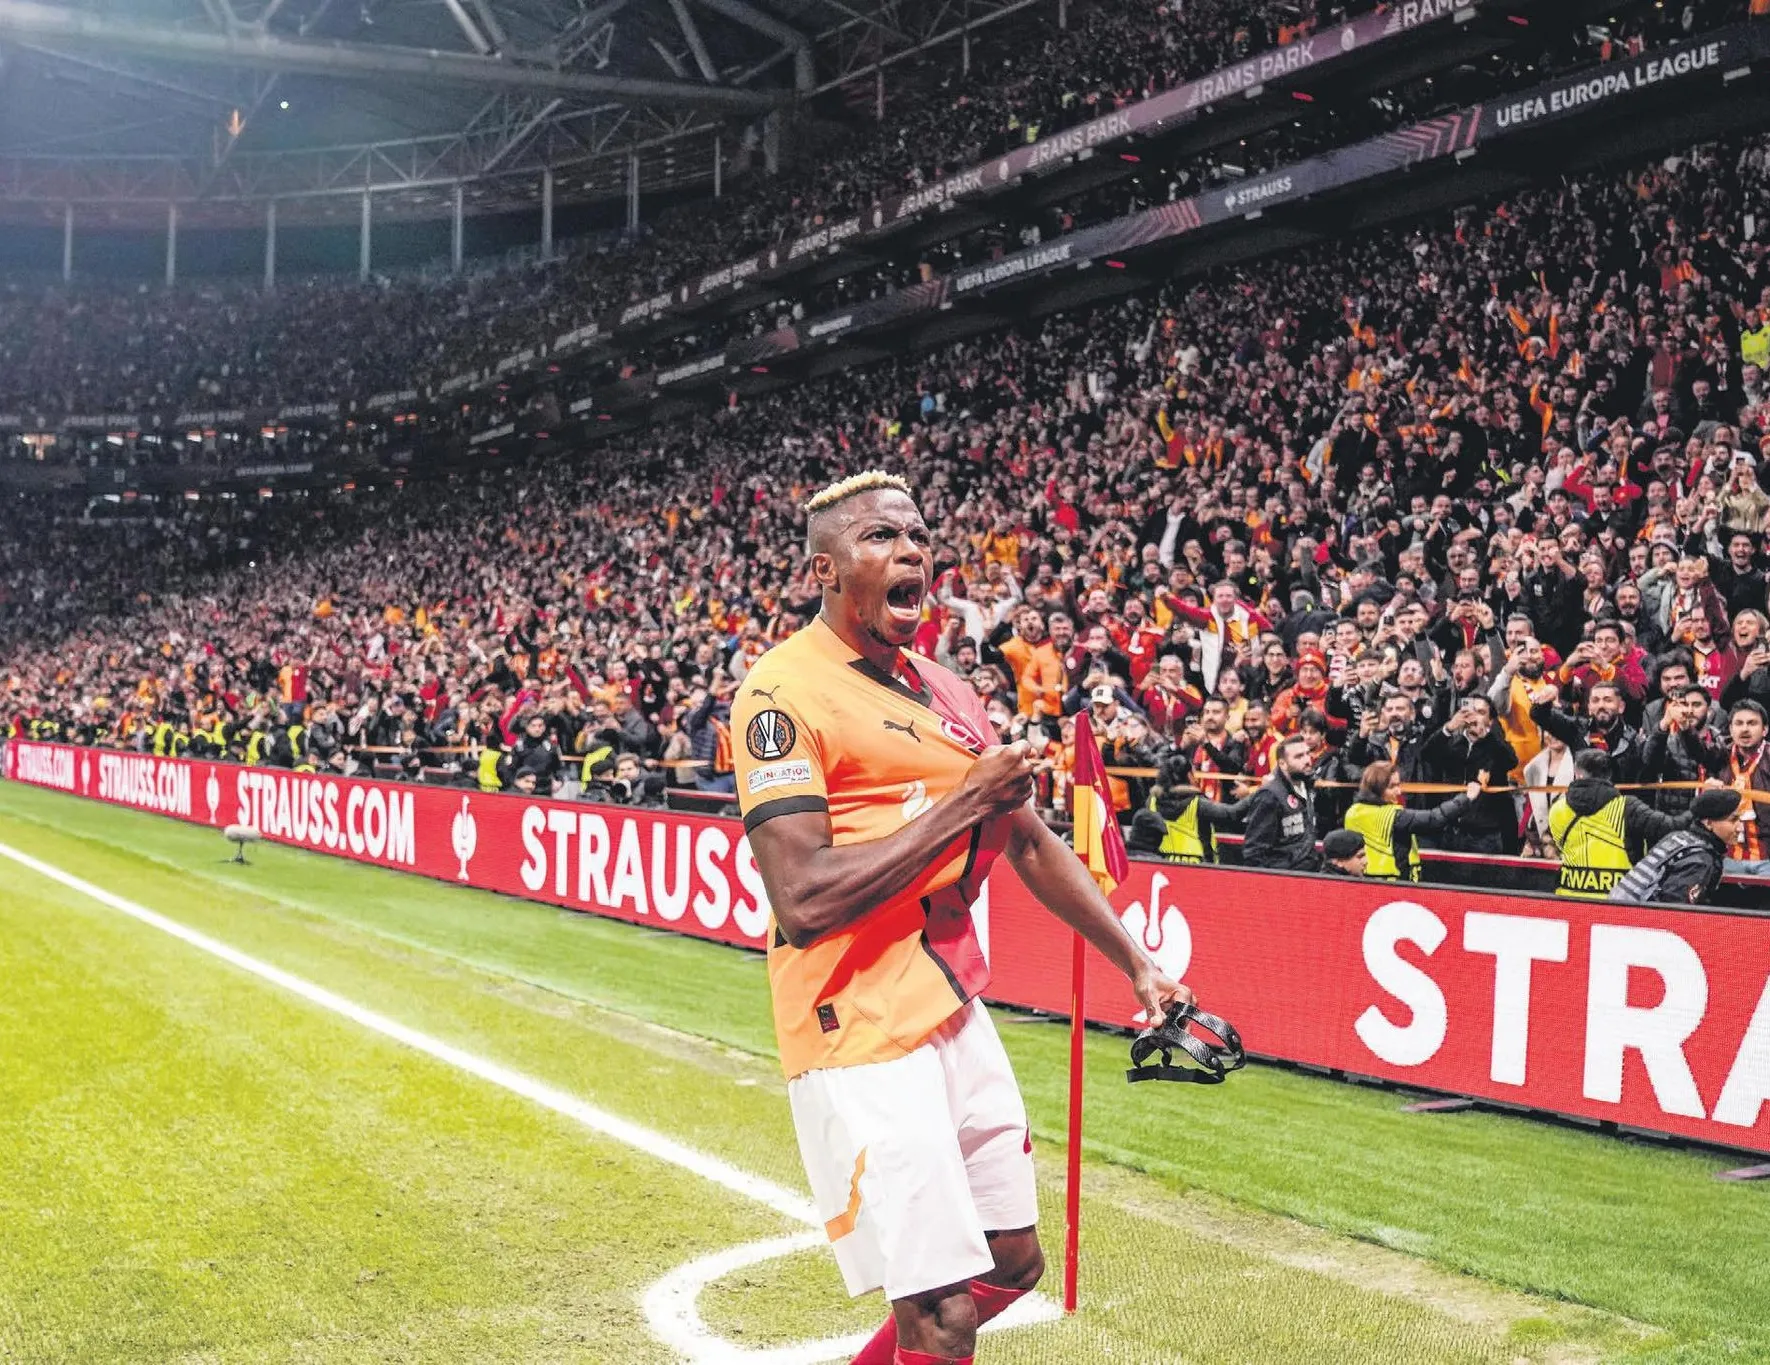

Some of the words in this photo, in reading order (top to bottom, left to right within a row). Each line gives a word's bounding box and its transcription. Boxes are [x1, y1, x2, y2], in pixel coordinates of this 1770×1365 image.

[1201, 64, 1255, 102] RAMS
[1261, 40, 1314, 79] PARK
[1496, 97, 1547, 127] UEFA
[1550, 70, 1631, 111] EUROPA
[1635, 42, 1720, 87] LEAGUE
[1039, 130, 1083, 163] RAMS
[1086, 111, 1131, 146] PARK
[1237, 176, 1292, 205] STRAUSS
[99, 753, 191, 816] STRAUSS.COM
[237, 770, 416, 865] STRAUSS.COM
